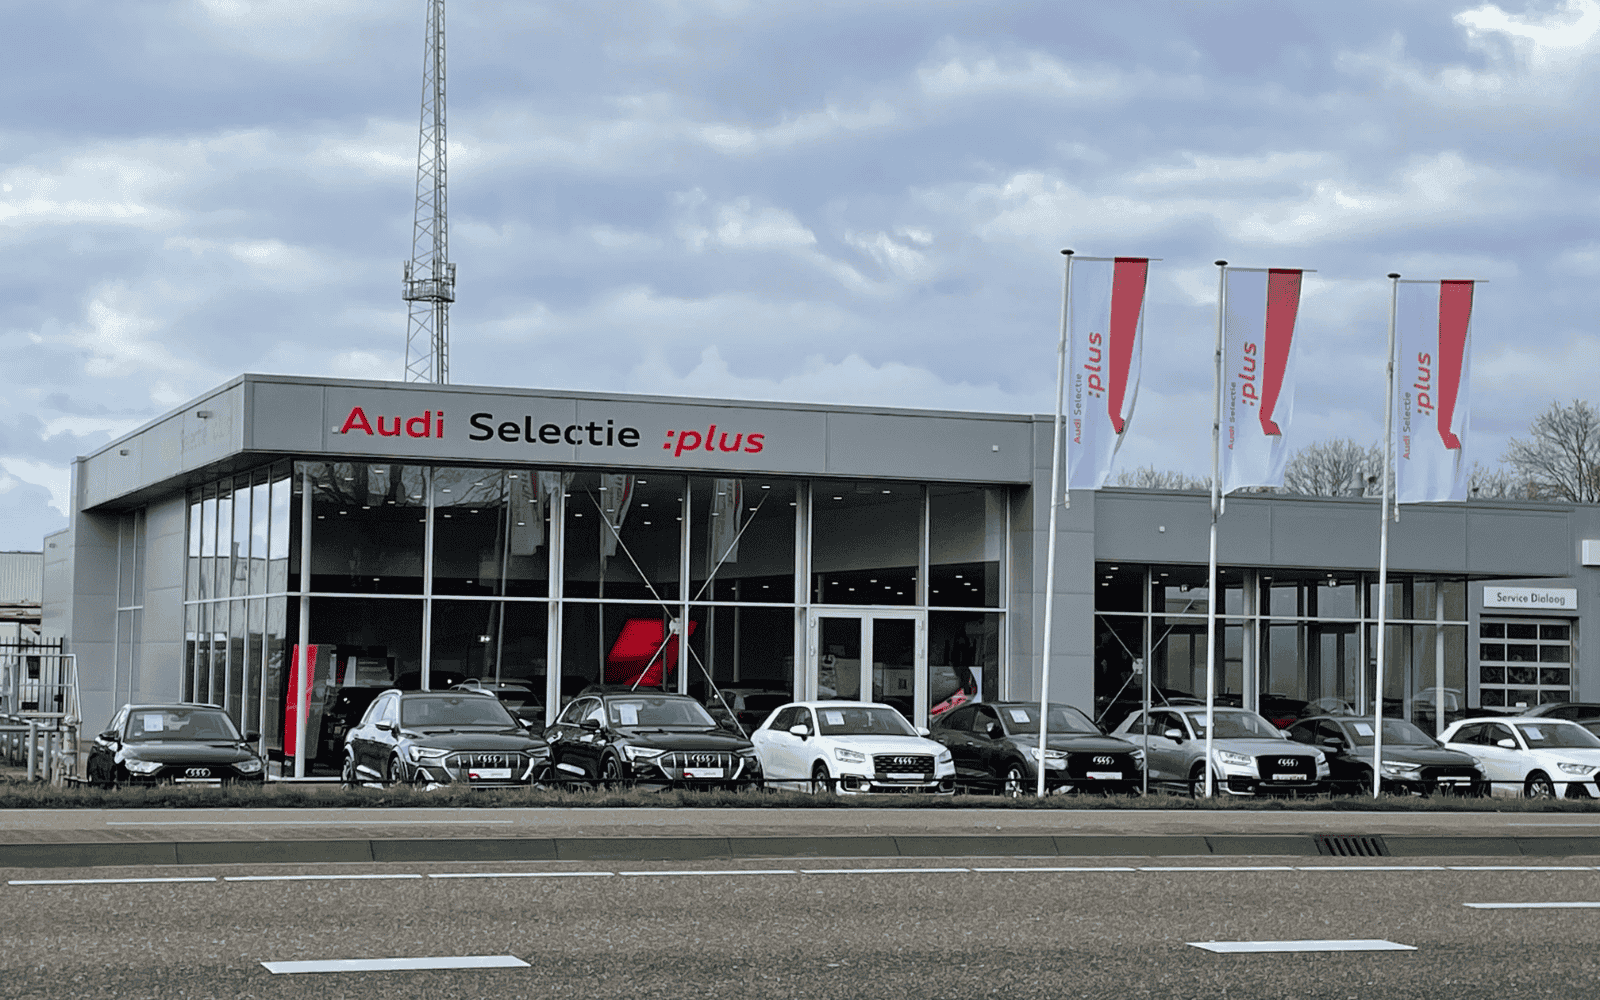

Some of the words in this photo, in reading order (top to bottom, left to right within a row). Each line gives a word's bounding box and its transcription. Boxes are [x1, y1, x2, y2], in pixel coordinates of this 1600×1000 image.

[1074, 373, 1082, 415] Selectie
[1403, 392, 1411, 432] Selectie
[340, 406, 444, 438] Audi
[468, 412, 640, 448] Selectie
[662, 425, 765, 457] :plus
[1073, 418, 1081, 444] Audi
[1496, 592, 1528, 603] Service
[1531, 593, 1565, 606] Dialoog
